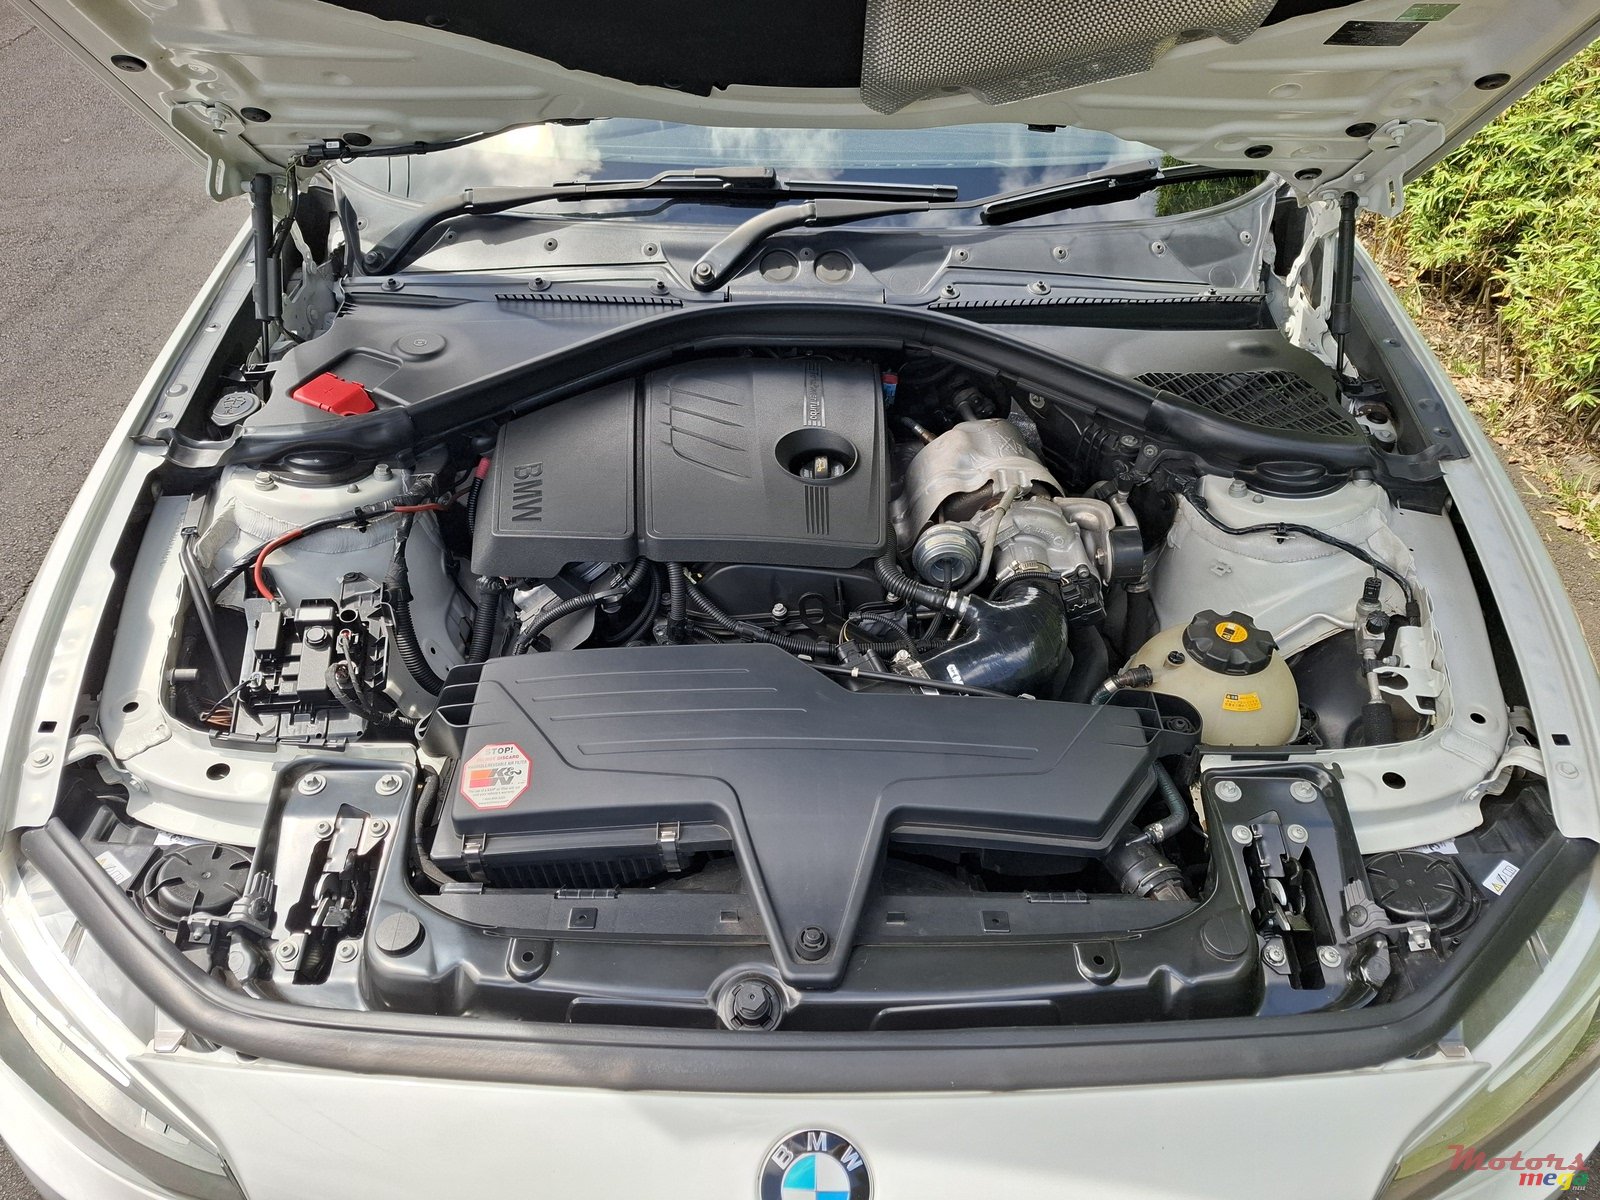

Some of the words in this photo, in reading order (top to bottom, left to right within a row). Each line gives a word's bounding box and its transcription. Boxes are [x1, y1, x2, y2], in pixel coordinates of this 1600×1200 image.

[809, 401, 820, 420] Turbo
[511, 461, 543, 522] BMW
[771, 1131, 863, 1172] BMW
